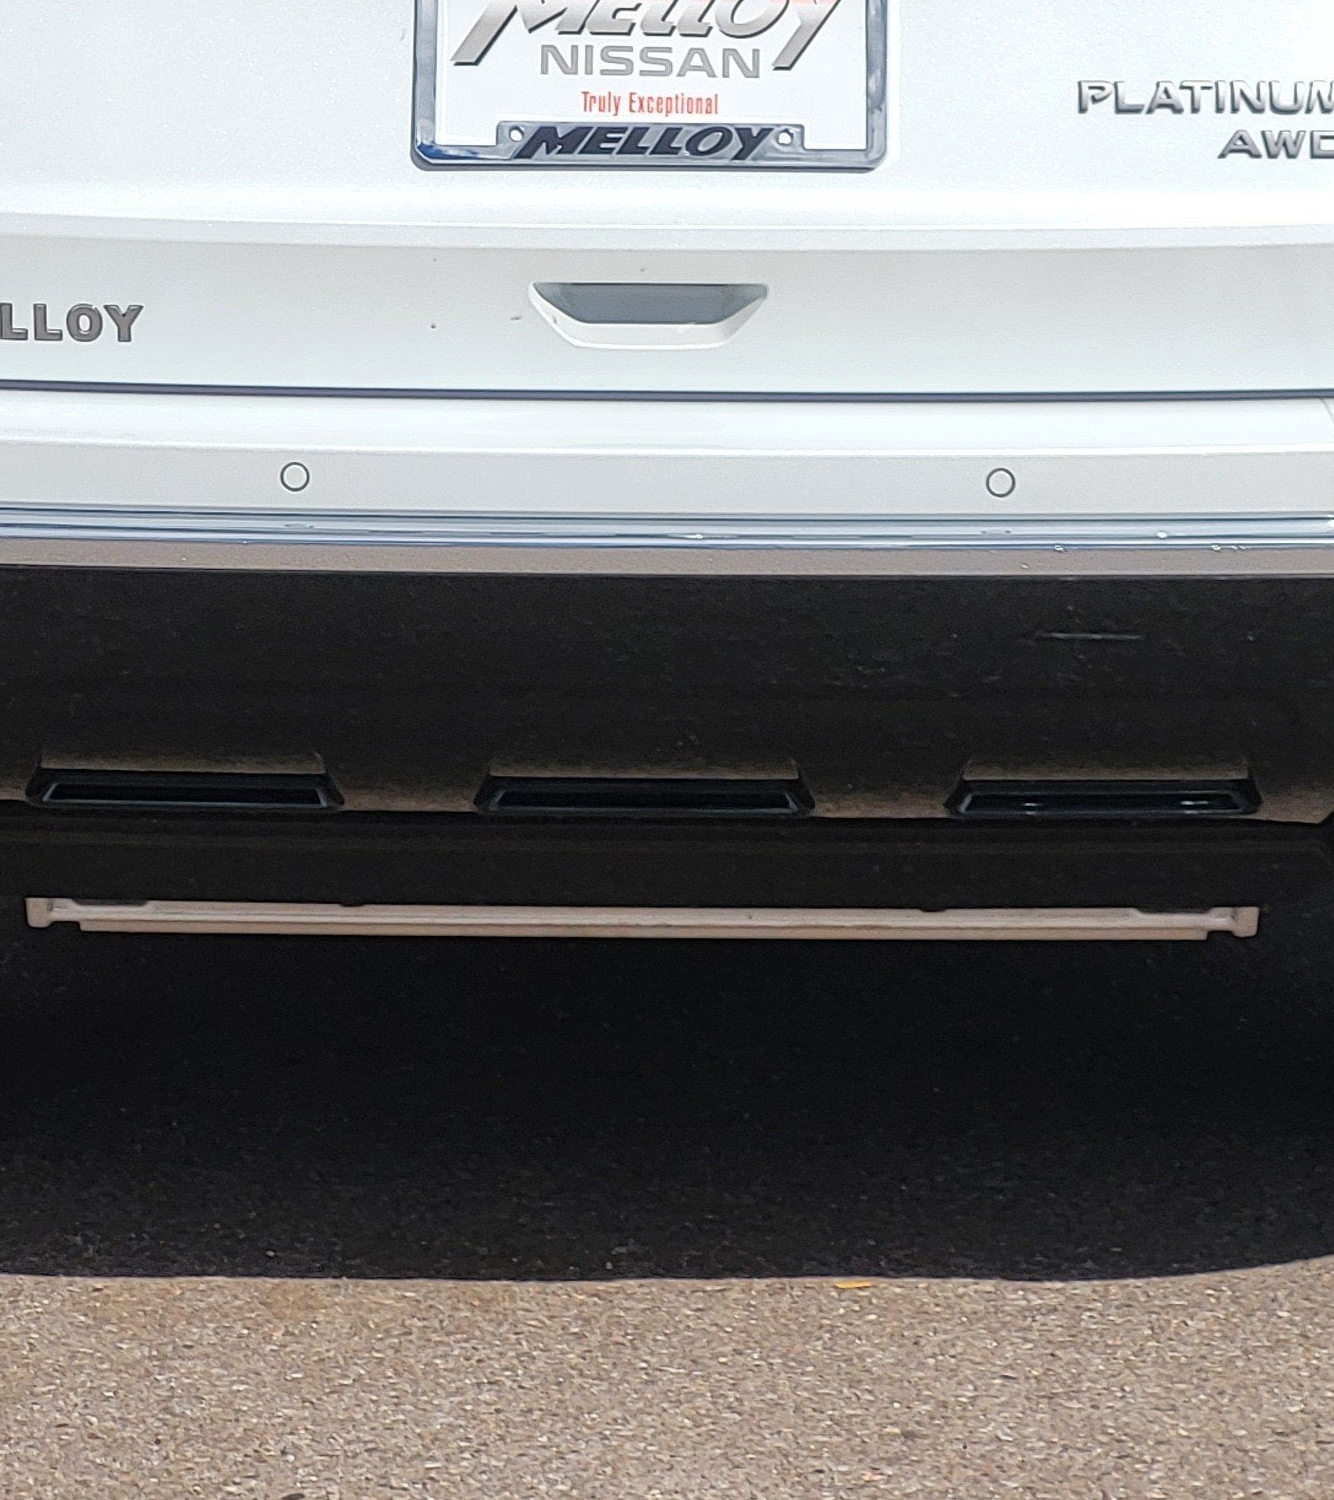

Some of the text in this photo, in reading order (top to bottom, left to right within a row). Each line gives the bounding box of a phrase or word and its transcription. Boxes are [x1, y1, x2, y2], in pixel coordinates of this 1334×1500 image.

[540, 44, 761, 79] NISSAN
[581, 91, 720, 117] Truly Exceptional
[512, 126, 775, 161] MELLOY
